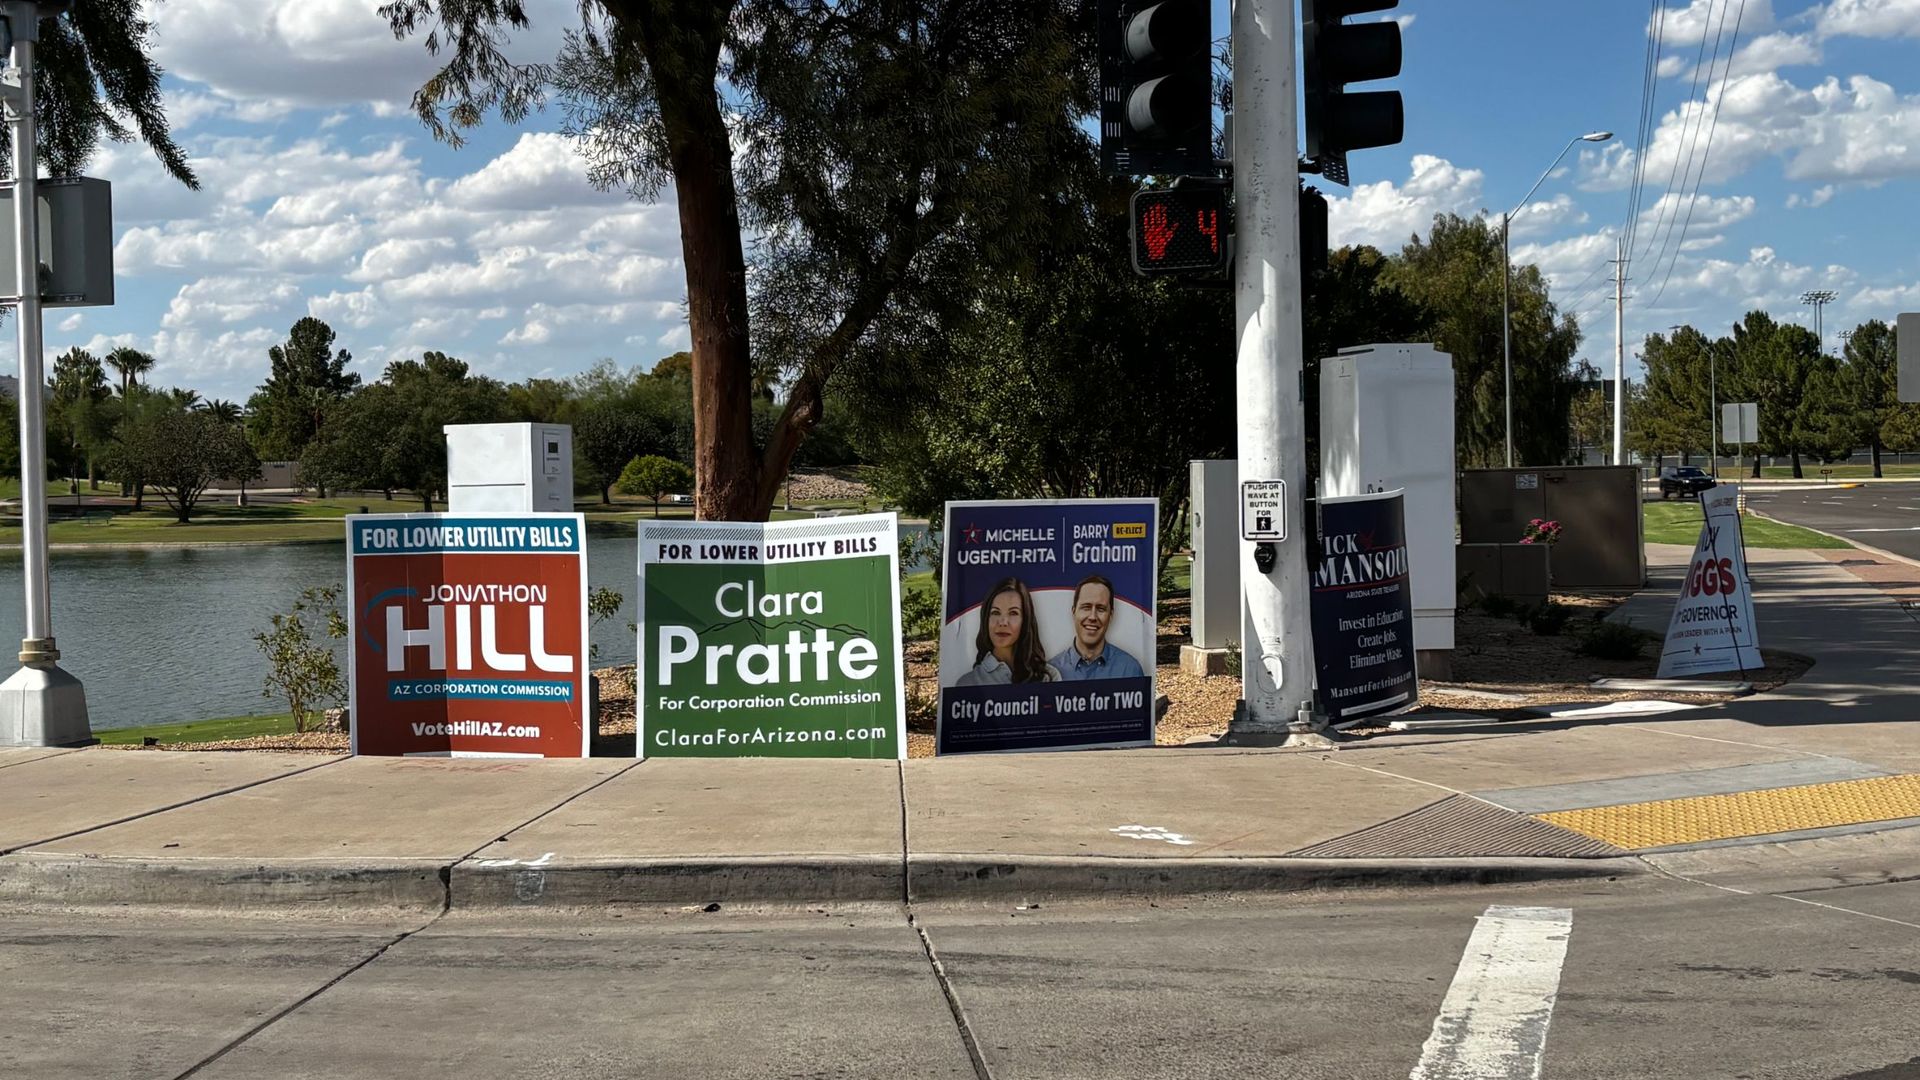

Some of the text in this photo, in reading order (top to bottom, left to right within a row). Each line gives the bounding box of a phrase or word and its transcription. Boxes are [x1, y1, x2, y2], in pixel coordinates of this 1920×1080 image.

[1198, 209, 1217, 253] 4
[362, 526, 573, 548] FOR LOWER UTILITY BILLS
[985, 528, 1055, 542] MICHELLE
[1073, 524, 1110, 540] BARRY
[659, 537, 877, 560] FOR LOWER UTILITY BILLS
[957, 548, 1056, 565] UGENTI-RITA
[1072, 542, 1136, 564] Graham
[422, 584, 547, 603] JONATHON
[715, 580, 823, 618] Clara
[1338, 617, 1366, 632] Invest
[1367, 614, 1376, 628] in
[1681, 604, 1738, 624] GOVERNOR
[386, 604, 574, 673] HILL
[1357, 634, 1383, 649] Create
[658, 625, 878, 686] Pratte
[1349, 652, 1386, 669] Eliminate
[394, 684, 570, 696] AZ CORPORATION COMMISSION
[659, 690, 881, 712] For Corporation Commission
[952, 691, 1143, 723] City Council Vote for TWO
[412, 720, 540, 738] VoteHillAZ.com
[655, 727, 886, 747] ClaraForArizona.com
